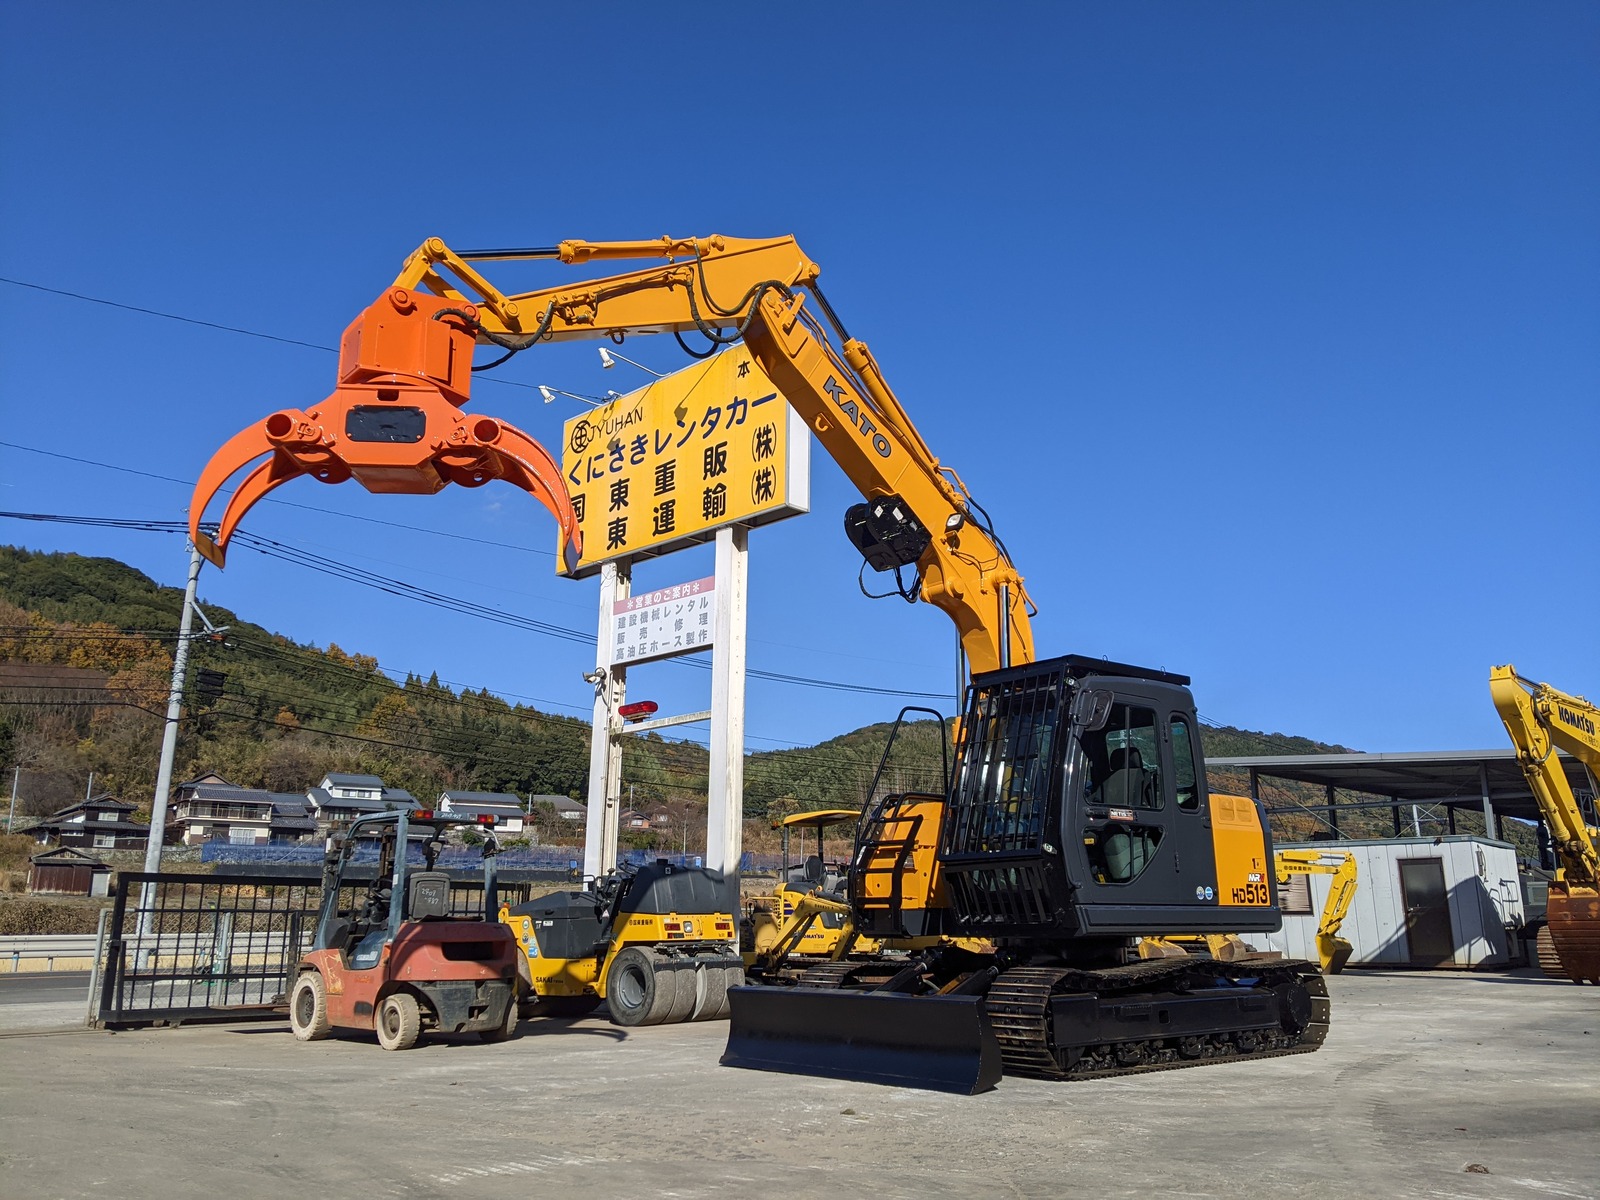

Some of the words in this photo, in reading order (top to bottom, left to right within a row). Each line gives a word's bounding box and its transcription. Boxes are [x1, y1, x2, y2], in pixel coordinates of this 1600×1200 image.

[737, 360, 750, 379] 本
[587, 407, 643, 442] JYUHAN
[822, 374, 892, 458] KATO
[568, 392, 778, 486] くにさきレンタカー
[579, 464, 777, 559] 東運輸(株)
[617, 596, 709, 630] 建設機械レンタル
[615, 629, 708, 661] 高油圧ホース製作
[1558, 705, 1595, 736] KOMATSU
[1232, 884, 1268, 904] HD513
